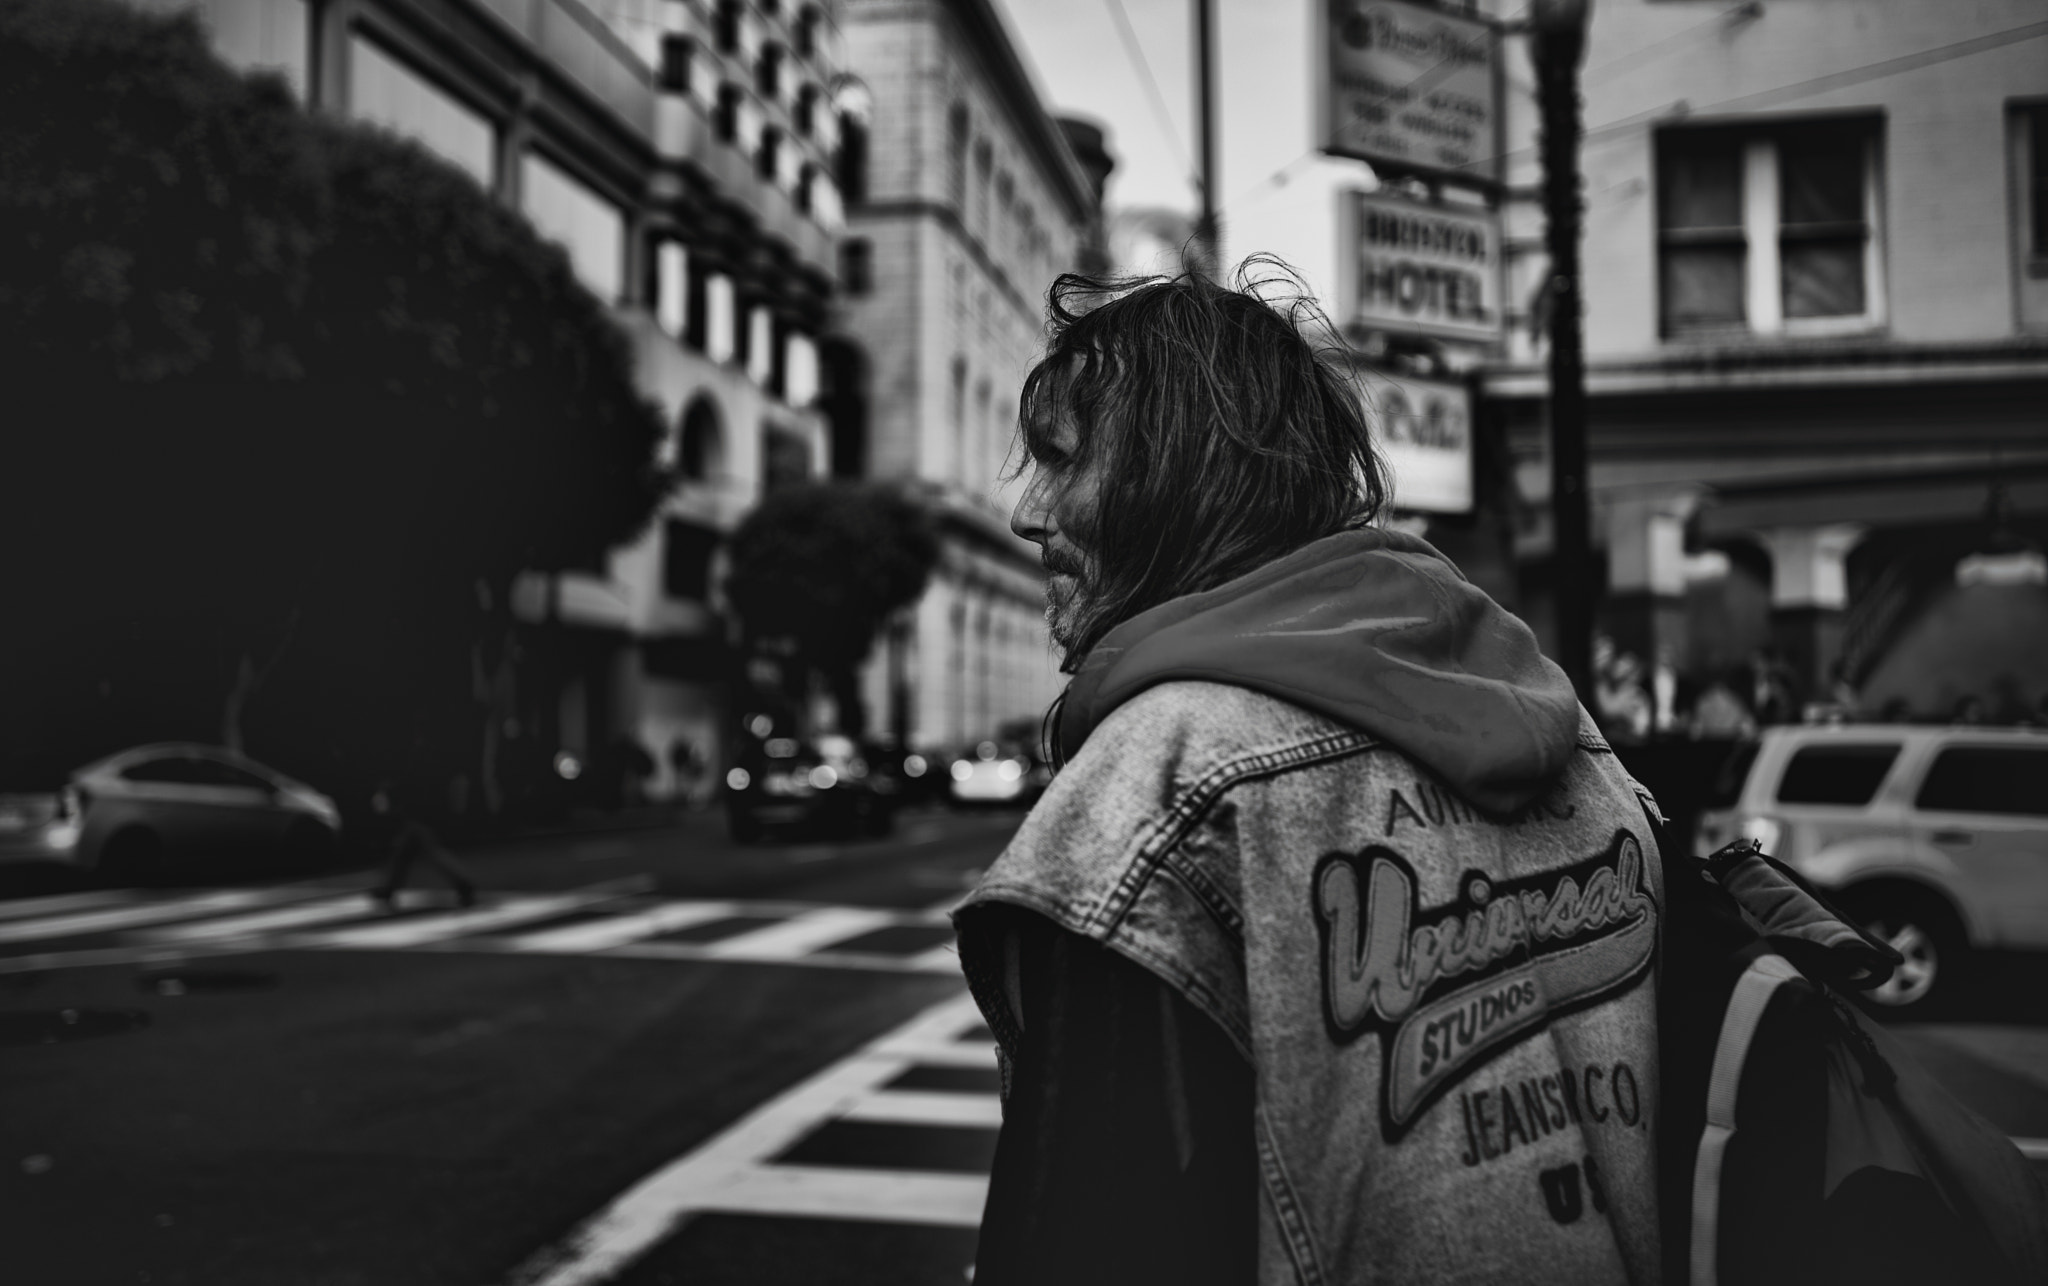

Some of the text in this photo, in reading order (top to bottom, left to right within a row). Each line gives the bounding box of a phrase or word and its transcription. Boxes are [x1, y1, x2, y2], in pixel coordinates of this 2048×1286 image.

[1363, 258, 1490, 322] HOTEL
[1419, 979, 1537, 1078] STUDIOS
[1583, 1060, 1648, 1133] CO.
